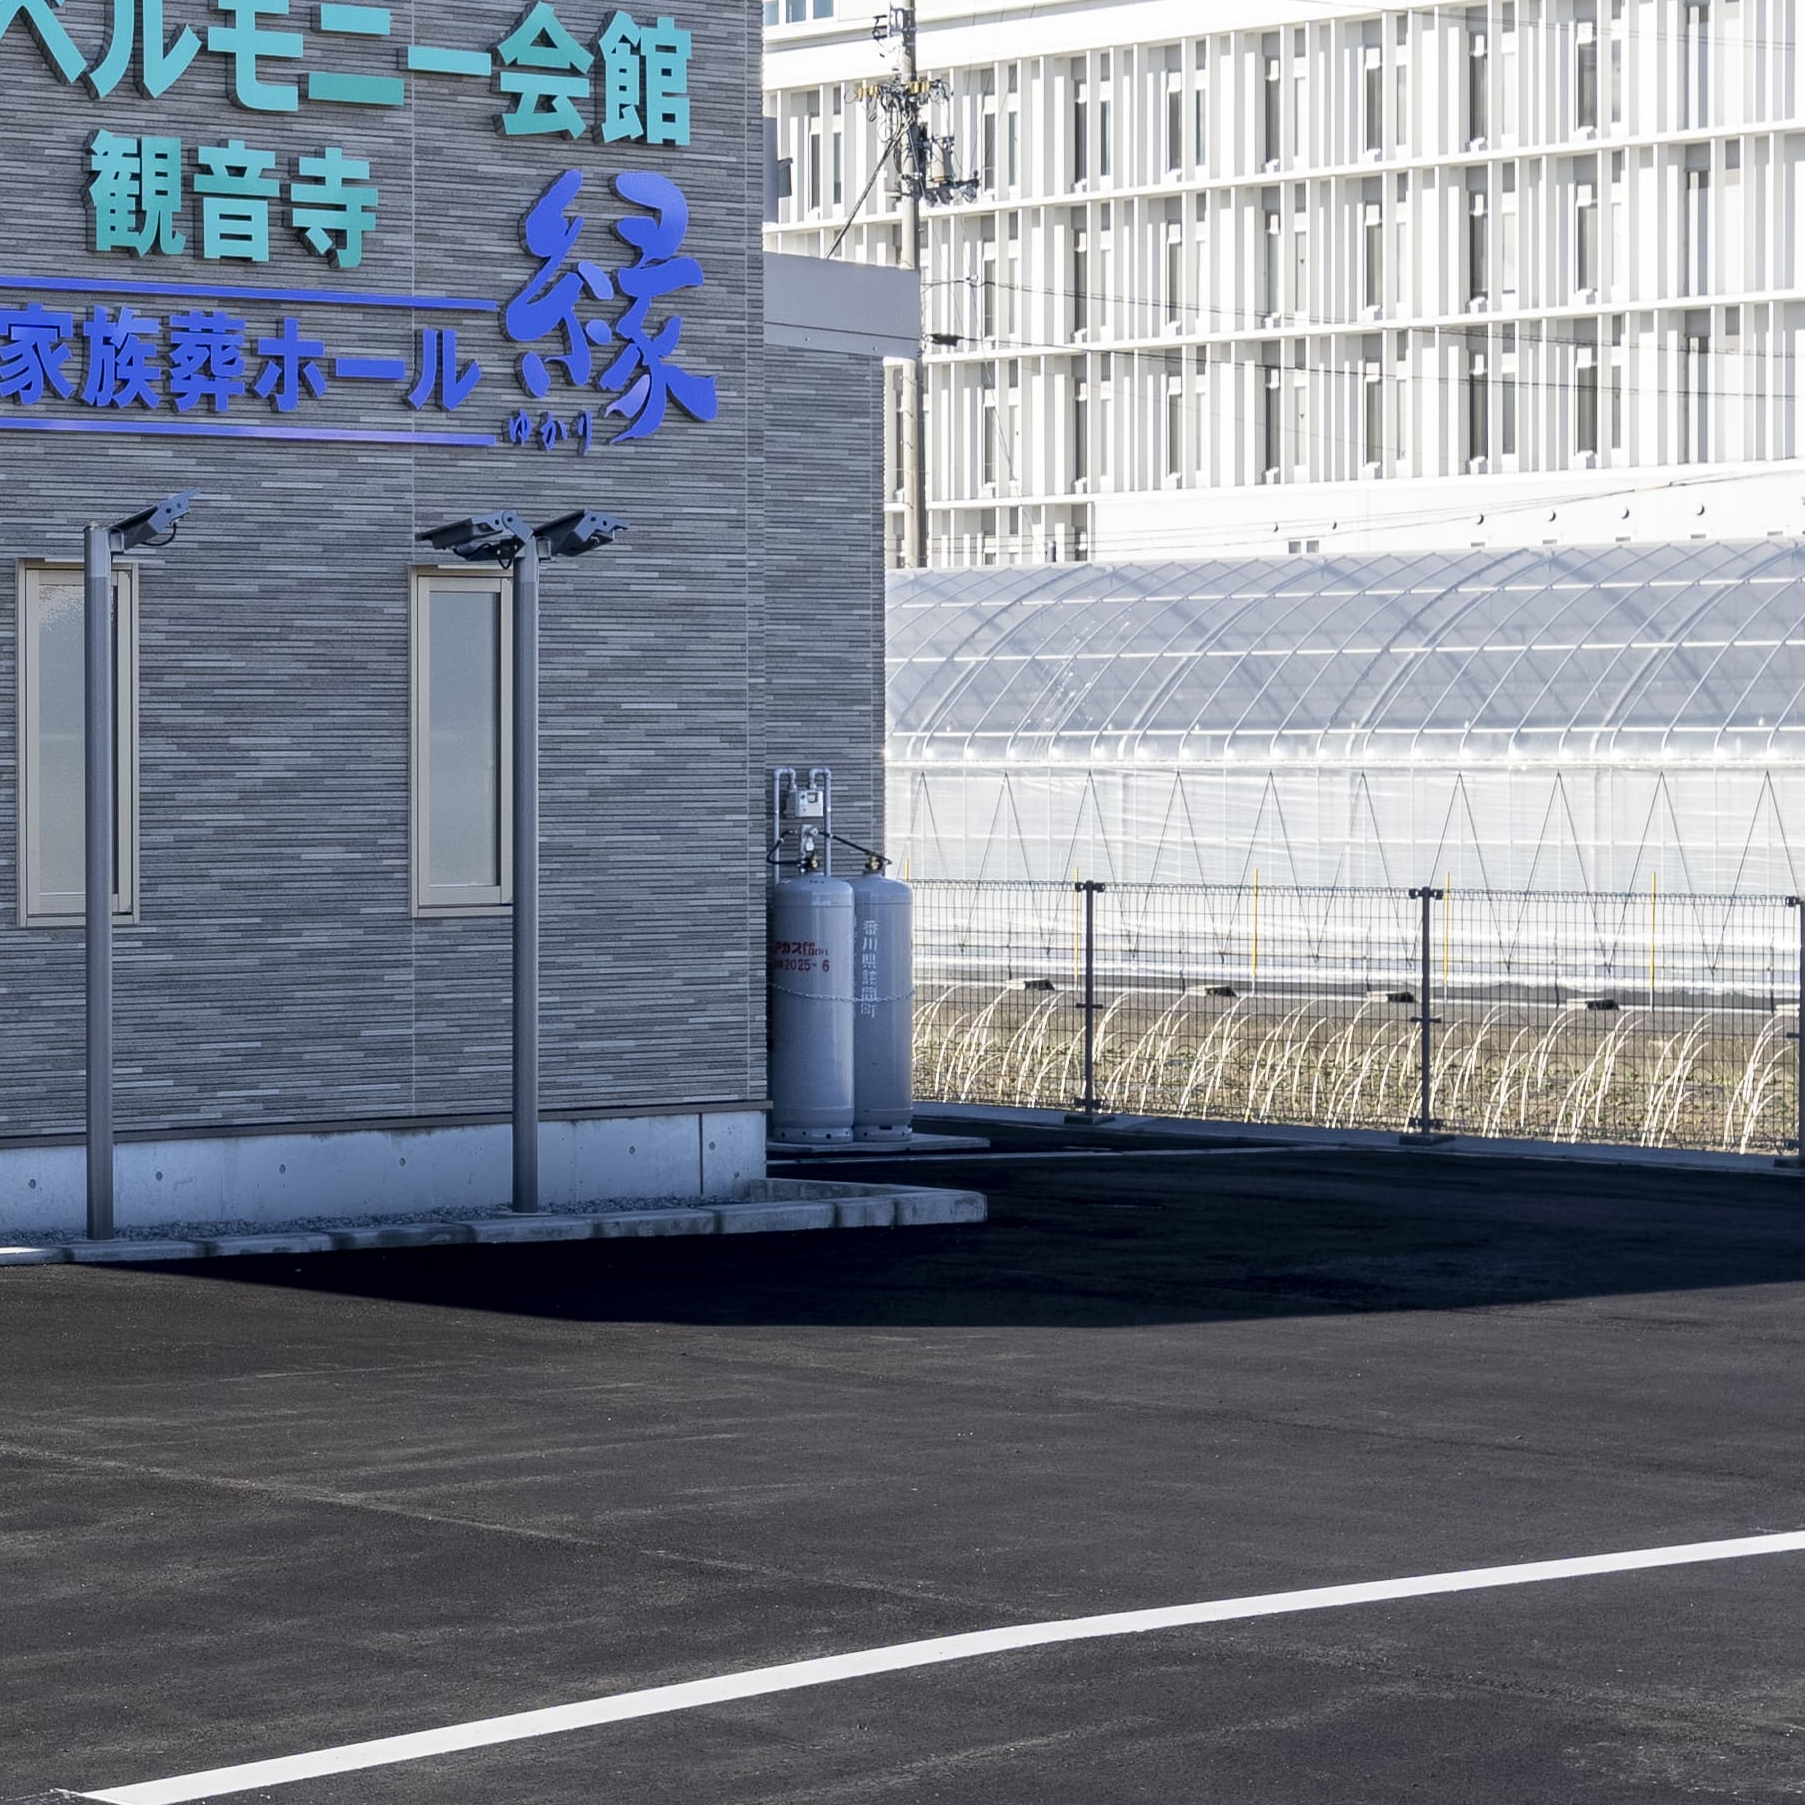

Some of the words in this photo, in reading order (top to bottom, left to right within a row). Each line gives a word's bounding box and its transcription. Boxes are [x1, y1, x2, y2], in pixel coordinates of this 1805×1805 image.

[85, 129, 380, 269] 観音寺
[501, 168, 719, 445] 縁
[503, 408, 592, 456] ゆかり
